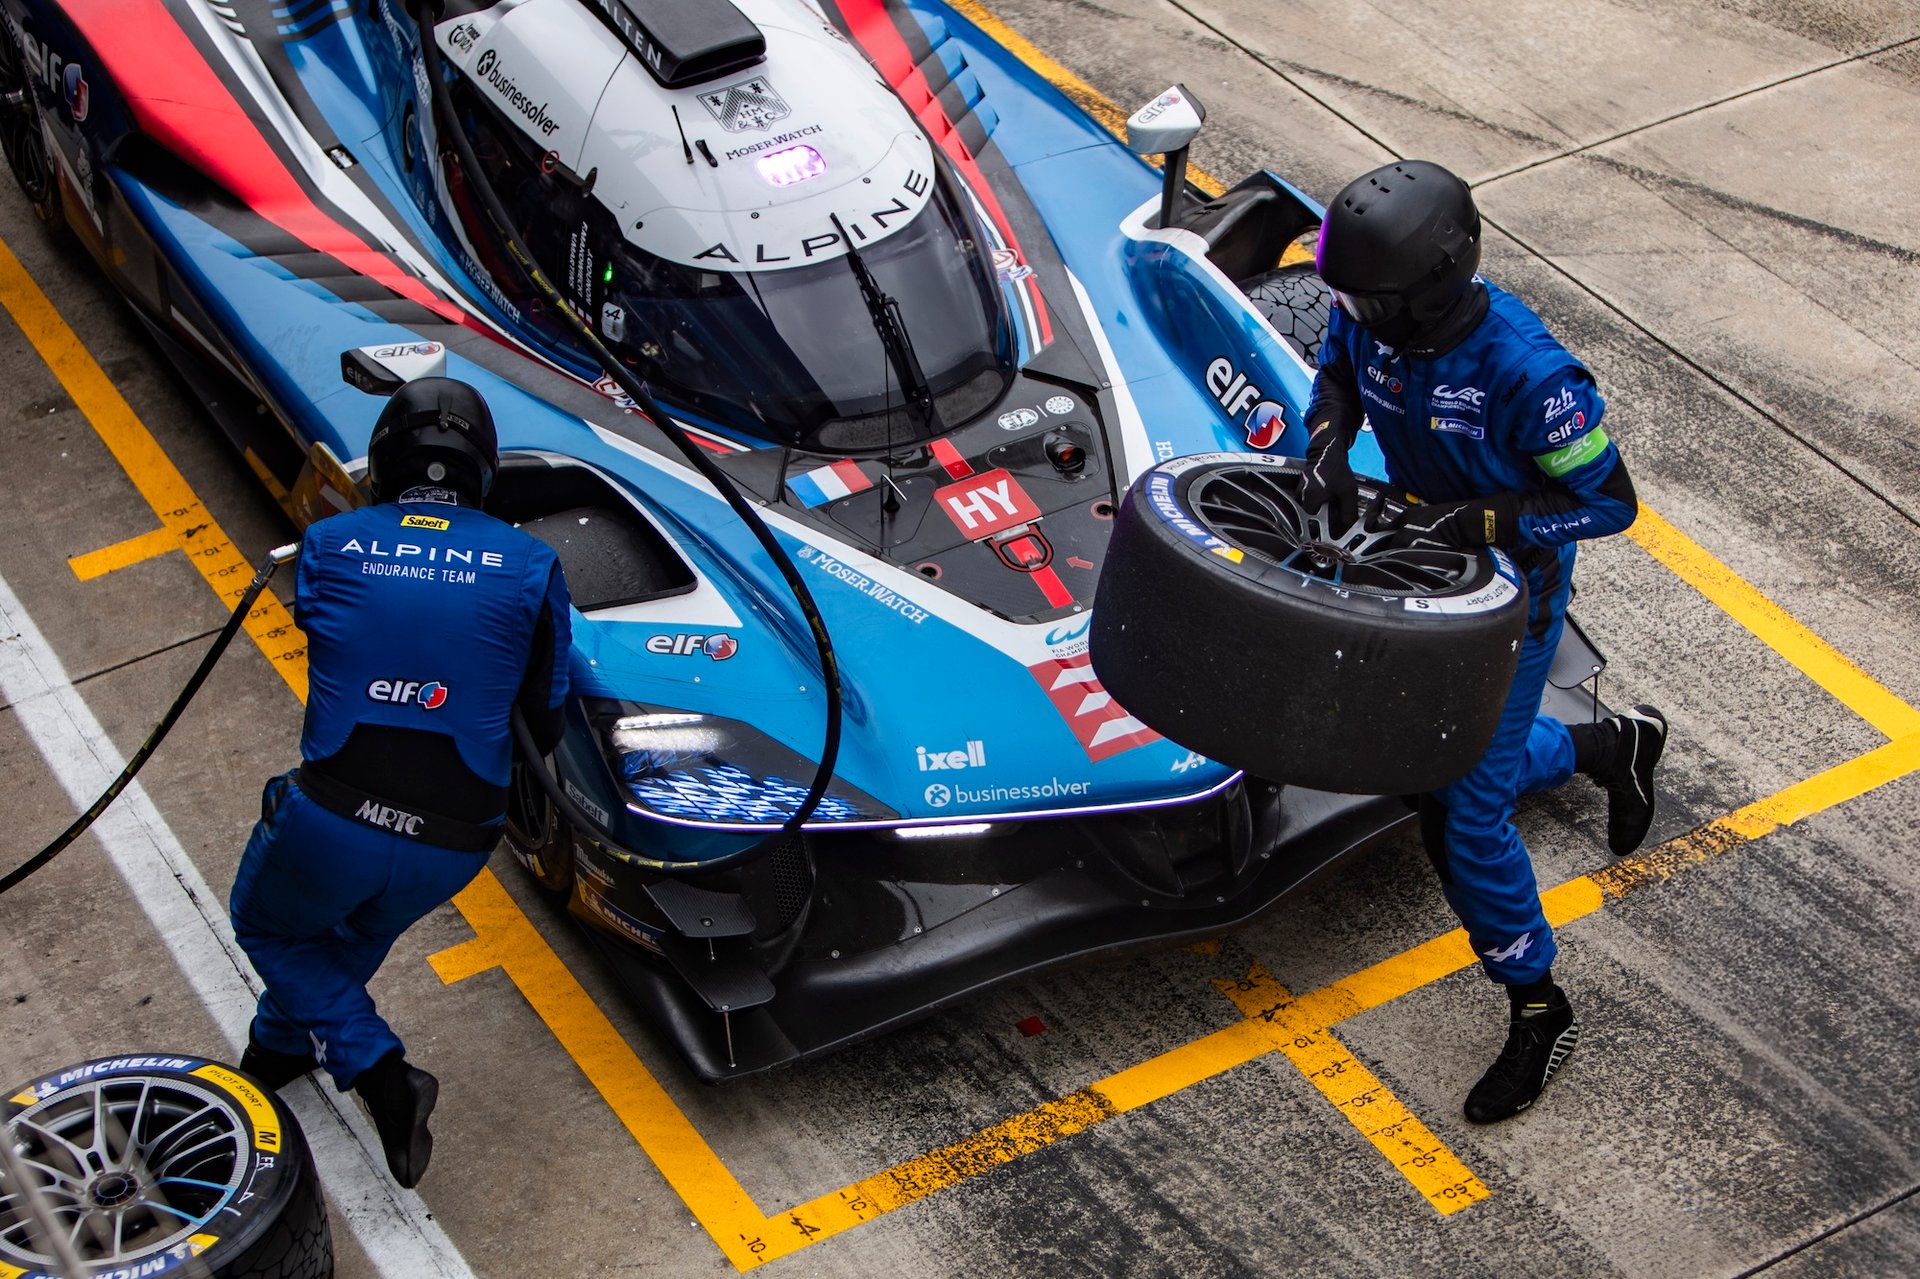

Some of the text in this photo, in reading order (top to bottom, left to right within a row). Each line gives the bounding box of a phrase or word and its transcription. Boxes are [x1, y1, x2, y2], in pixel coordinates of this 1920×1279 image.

[602, 0, 662, 69] ALTEN
[23, 32, 62, 93] elf
[488, 60, 560, 136] businessolver
[725, 124, 823, 161] MOSER.WATCH
[692, 169, 929, 263] ALPINE
[374, 346, 416, 358] elf
[1206, 357, 1260, 417] elf
[1367, 365, 1388, 385] elf
[1433, 384, 1485, 405] WEC
[1544, 387, 1573, 420] 24h
[1547, 420, 1573, 444] elf
[947, 479, 1018, 529] HY
[1151, 477, 1207, 536] MICHELIN
[406, 516, 444, 529] Sabelt
[341, 538, 503, 567] ALPINE
[362, 562, 476, 584] ENDURANCE TEAM
[811, 553, 928, 623] MOSER.WATCH
[646, 634, 704, 655] elf
[1066, 640, 1090, 651] WORL
[368, 680, 419, 703] elf
[916, 740, 986, 771] ixell
[568, 783, 604, 823] Sabelt
[955, 777, 1091, 803] businessolver
[355, 800, 424, 835] MRTC
[60, 1057, 192, 1085] MICHELIN
[208, 1068, 263, 1108] PILOT SPORT
[258, 1131, 276, 1146] M
